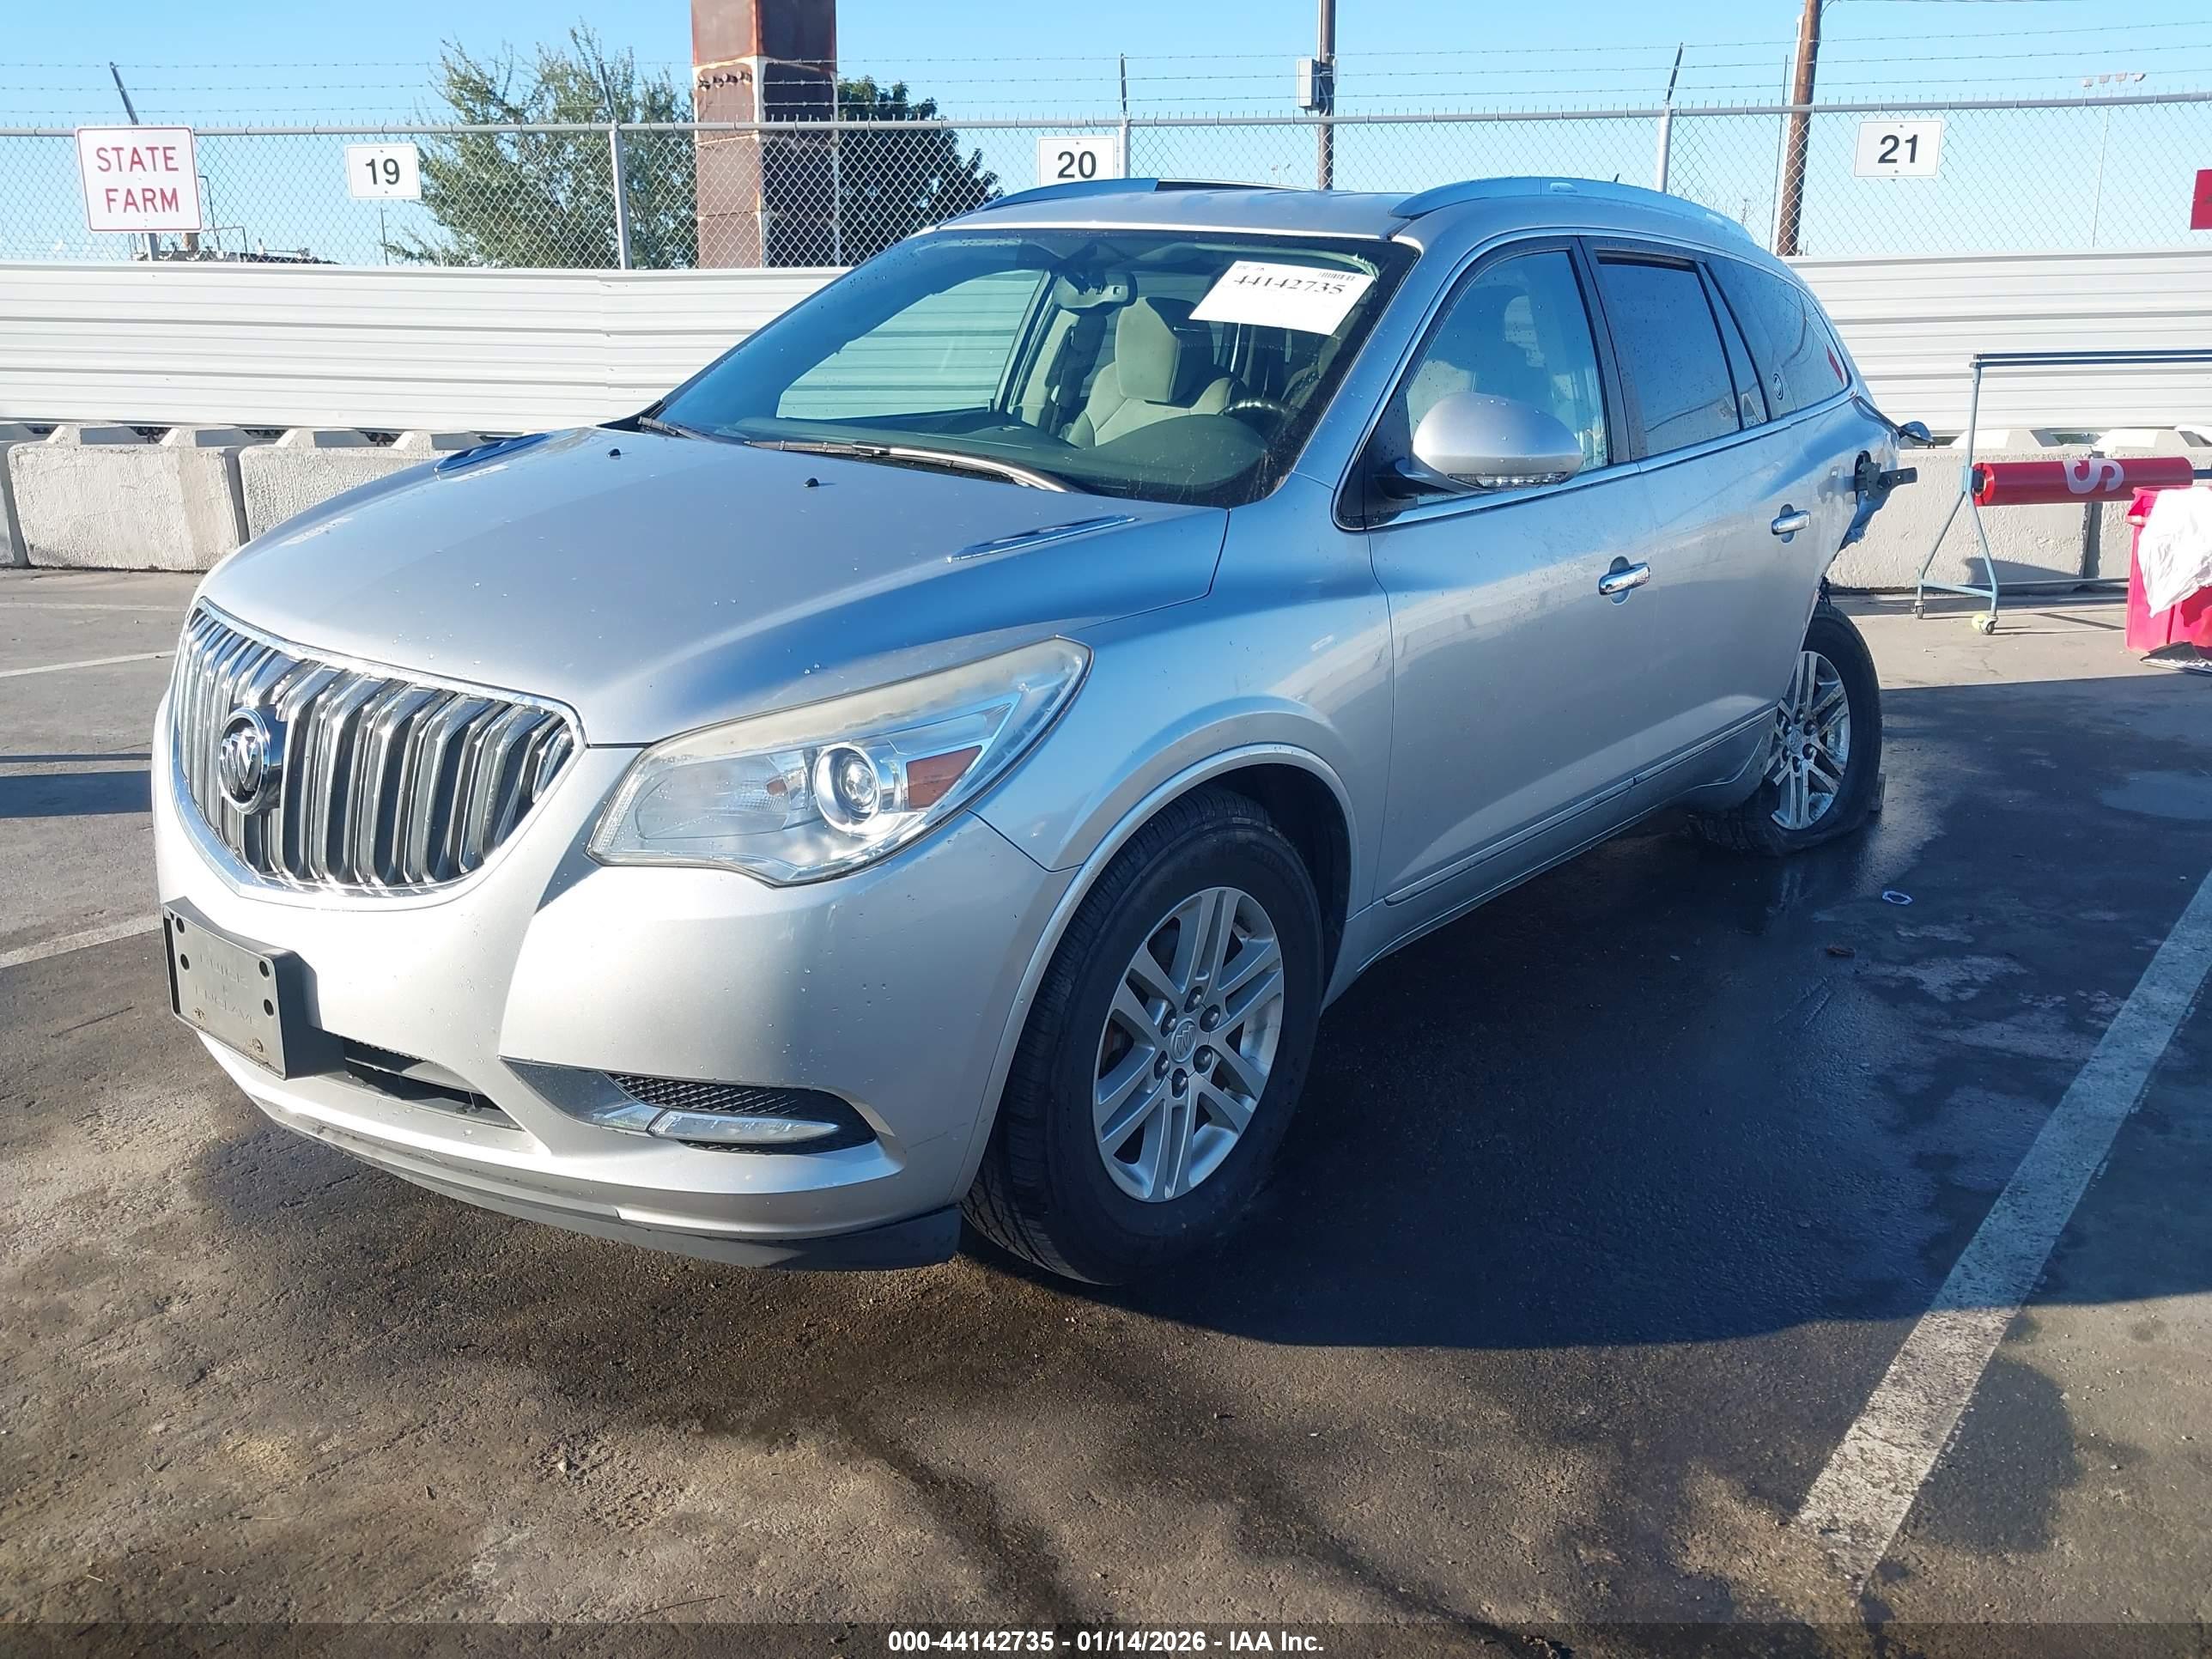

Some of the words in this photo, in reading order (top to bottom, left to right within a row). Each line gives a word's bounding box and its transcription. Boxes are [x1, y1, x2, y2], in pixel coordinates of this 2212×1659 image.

[96, 146, 179, 173] STATE
[1877, 134, 1918, 164] 21
[365, 158, 400, 185] 19
[1057, 150, 1097, 179] 20
[105, 187, 179, 214] FARM
[1234, 275, 1346, 295] 44142735
